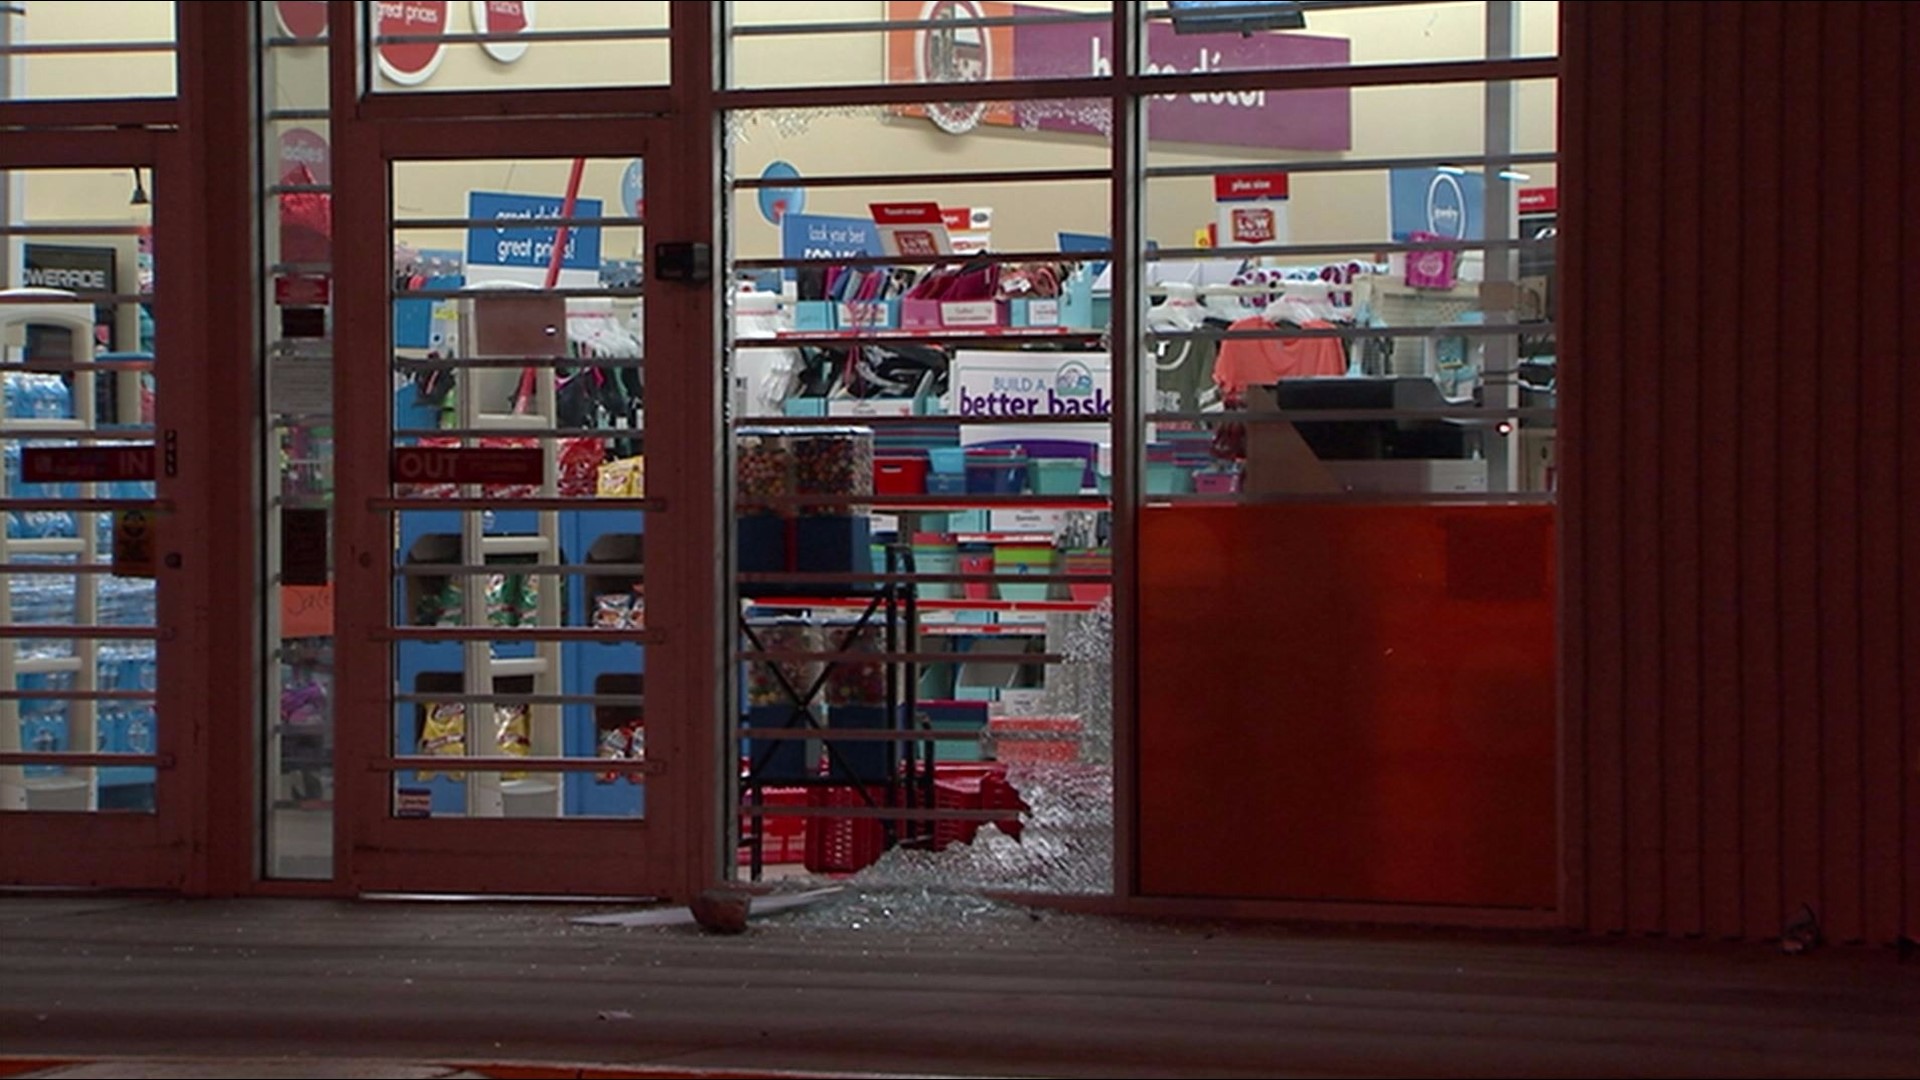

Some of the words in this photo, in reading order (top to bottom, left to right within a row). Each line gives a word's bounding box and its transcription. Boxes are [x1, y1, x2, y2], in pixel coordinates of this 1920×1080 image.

[1237, 218, 1268, 230] LOW
[497, 238, 532, 263] great
[993, 376, 1033, 392] BUILD
[1036, 379, 1047, 392] A
[960, 386, 1039, 415] better
[119, 451, 149, 475] IN
[399, 453, 460, 478] OUT
